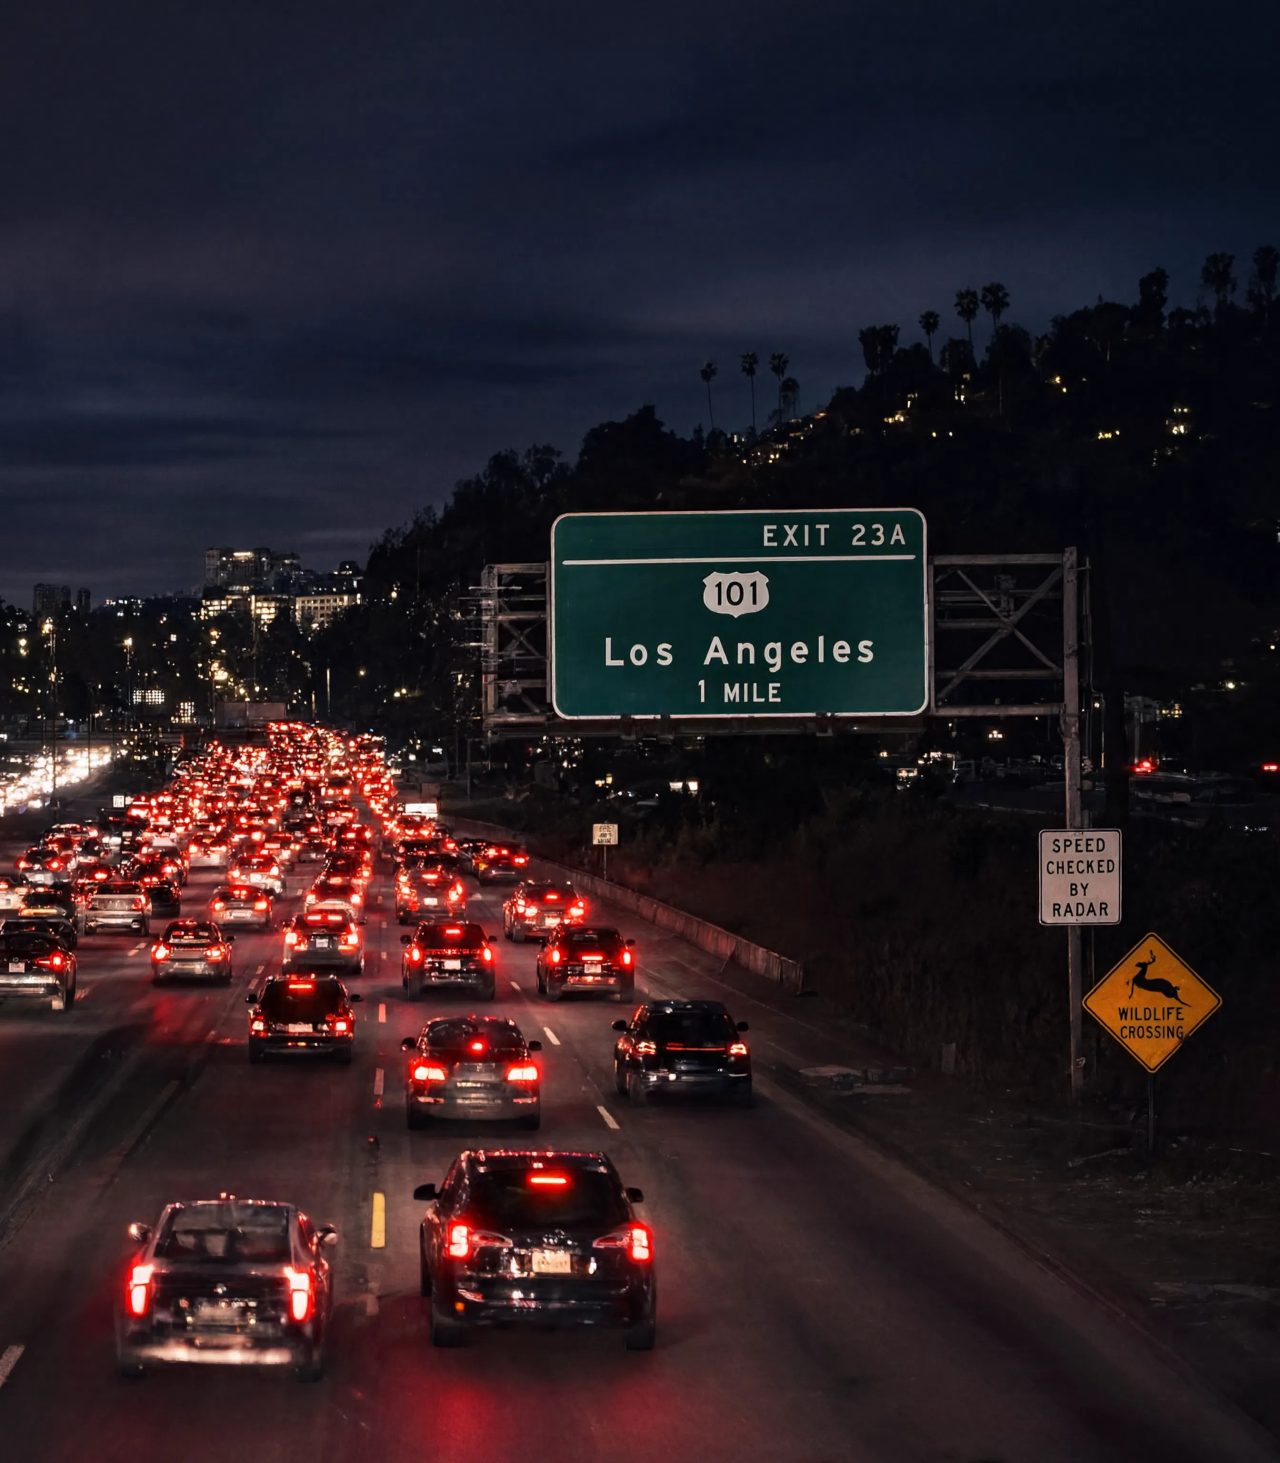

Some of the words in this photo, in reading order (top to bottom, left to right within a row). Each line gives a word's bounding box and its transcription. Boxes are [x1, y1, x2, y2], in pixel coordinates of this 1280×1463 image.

[763, 524, 830, 547] EXIT
[851, 523, 906, 546] 23A
[714, 580, 759, 607] 101
[605, 637, 674, 667] Los
[703, 635, 874, 673] Angeles
[698, 679, 706, 703] 1
[724, 682, 782, 703] MILE
[1052, 838, 1106, 853] SPEED
[1046, 859, 1115, 875] CHECKED
[1069, 883, 1089, 897] BY
[1052, 902, 1109, 917] RADAR
[1118, 1006, 1185, 1021] WILDLIFE
[1119, 1025, 1184, 1040] CROSSING
